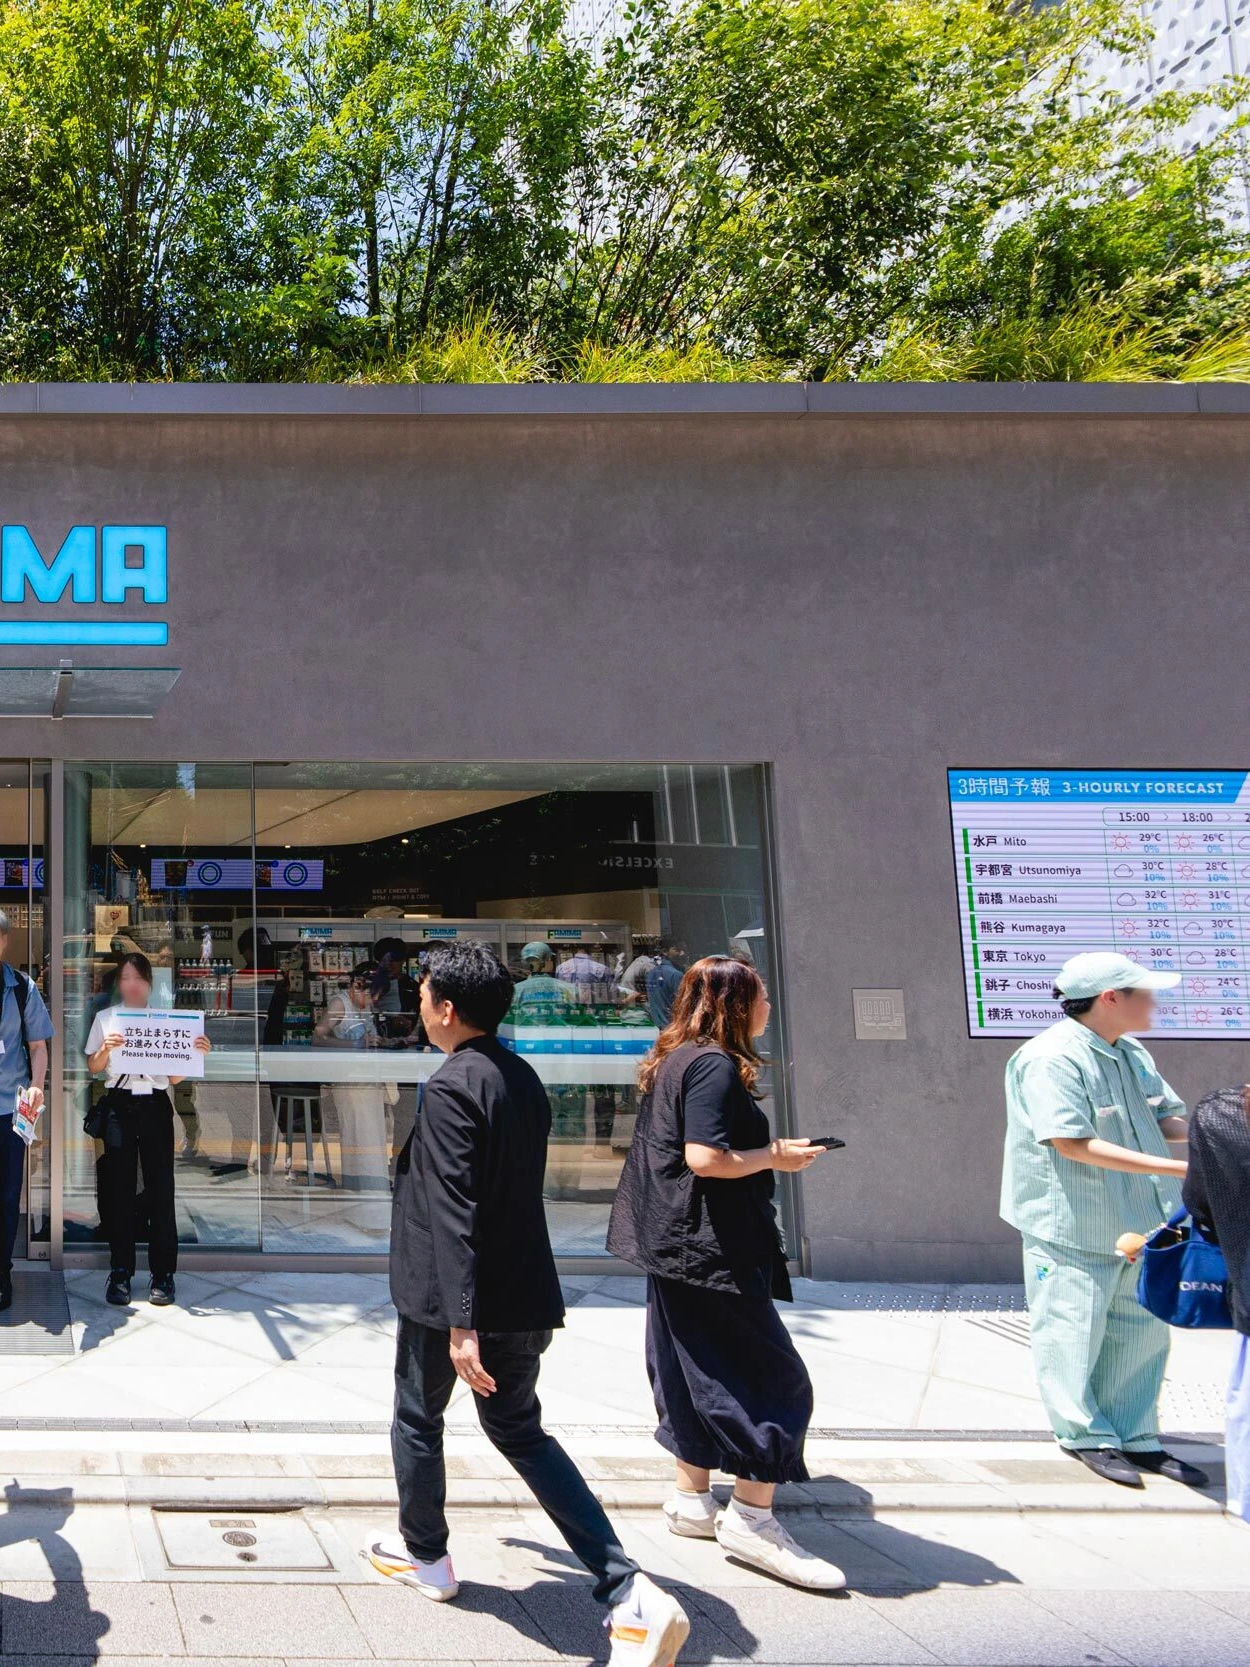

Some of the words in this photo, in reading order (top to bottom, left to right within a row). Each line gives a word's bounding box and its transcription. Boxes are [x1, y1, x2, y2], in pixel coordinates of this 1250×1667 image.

[958, 777, 1051, 797] 3時間予報
[1062, 782, 1140, 794] 3-HOURLY
[1146, 782, 1224, 795] FORECAST
[1119, 812, 1150, 823] 15:00
[1182, 812, 1213, 823] 18:00
[974, 835, 997, 848] 水戸
[1004, 837, 1027, 847] Mito
[975, 864, 1012, 876] 宇都宮
[1019, 865, 1081, 876] Utsunomiya
[978, 892, 1003, 904] 前橋
[1009, 894, 1058, 904] Maebashi
[980, 921, 1005, 934] 熊谷
[1012, 923, 1066, 934] Kumagaya
[422, 929, 457, 938] FAMIMA
[548, 929, 582, 939] FAMIMA
[983, 950, 1008, 963] 東京
[1014, 952, 1046, 962] Tokyo
[985, 978, 1010, 991] 銚子
[1017, 980, 1051, 990] Choshi
[988, 1007, 1013, 1020] 横浜
[1019, 1009, 1065, 1020] Yokoham
[125, 1027, 191, 1038] 立ち止まらずに
[125, 1039, 191, 1050] お進みください
[145, 1051, 162, 1059] keep
[164, 1052, 193, 1060] moving.
[1179, 1280, 1223, 1293] DEAN
